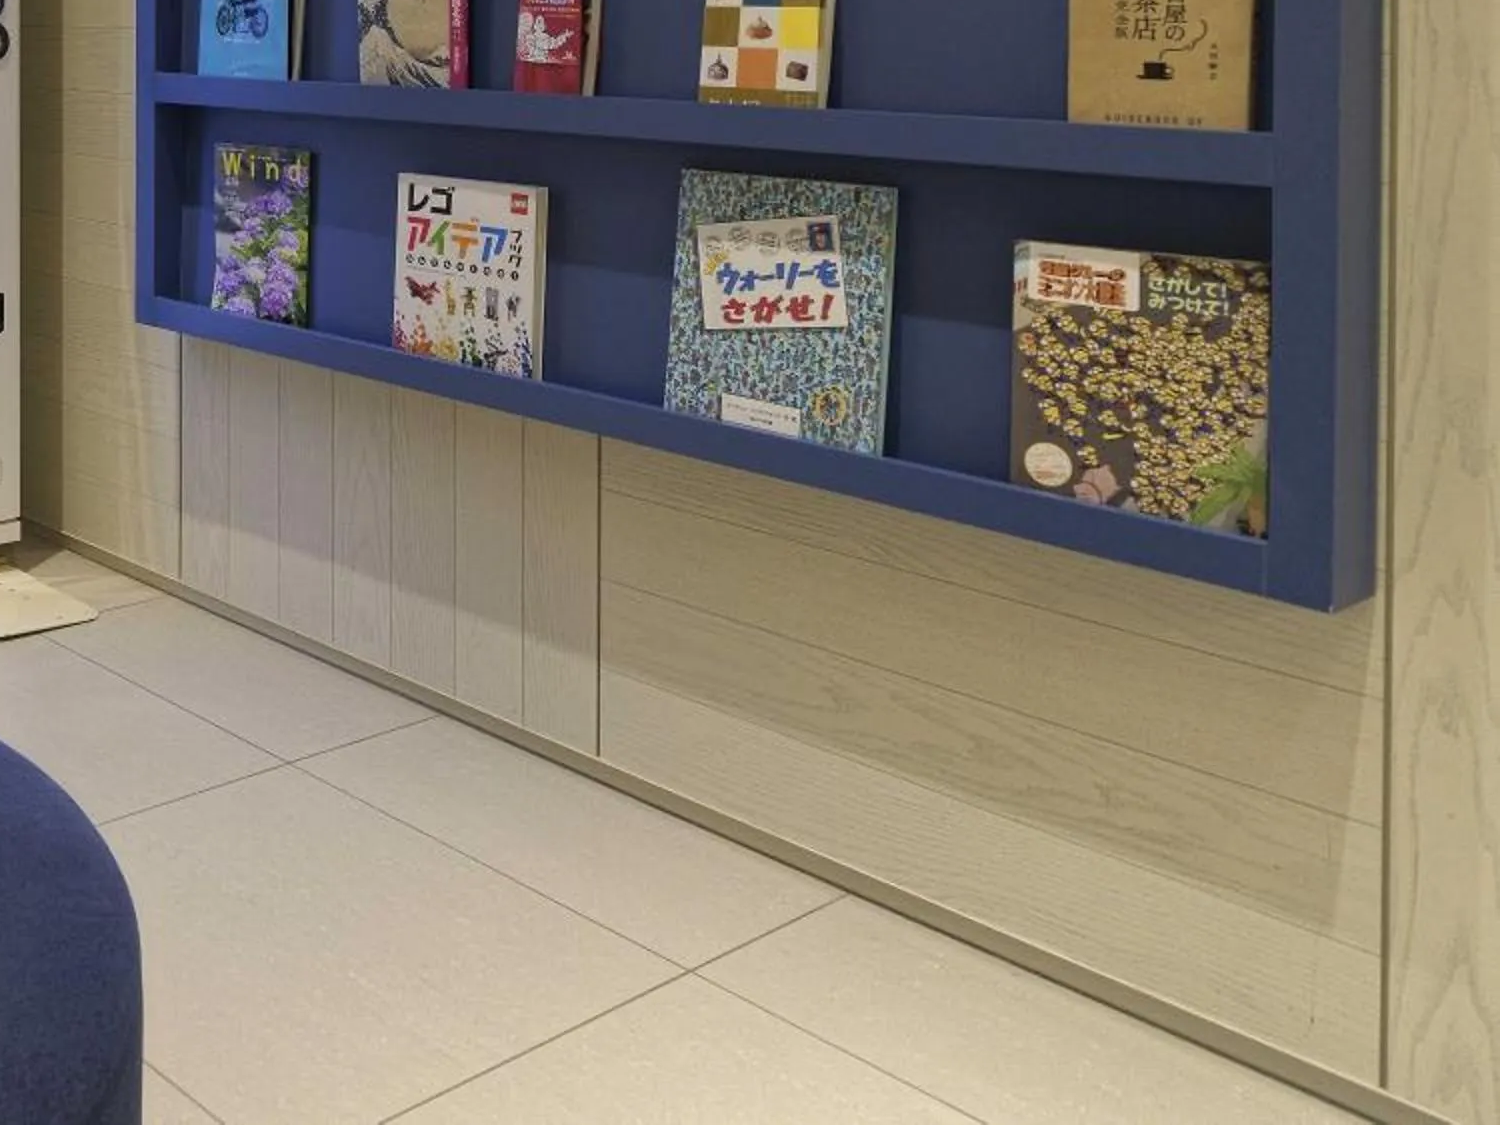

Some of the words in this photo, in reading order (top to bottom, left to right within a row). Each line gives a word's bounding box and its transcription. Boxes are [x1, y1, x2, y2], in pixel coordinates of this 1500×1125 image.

[221, 151, 303, 183] Wind
[407, 182, 456, 216] レゴ
[406, 216, 509, 264] アイデア
[716, 259, 841, 296] ウォーリーを
[720, 293, 835, 324] さがせ!
